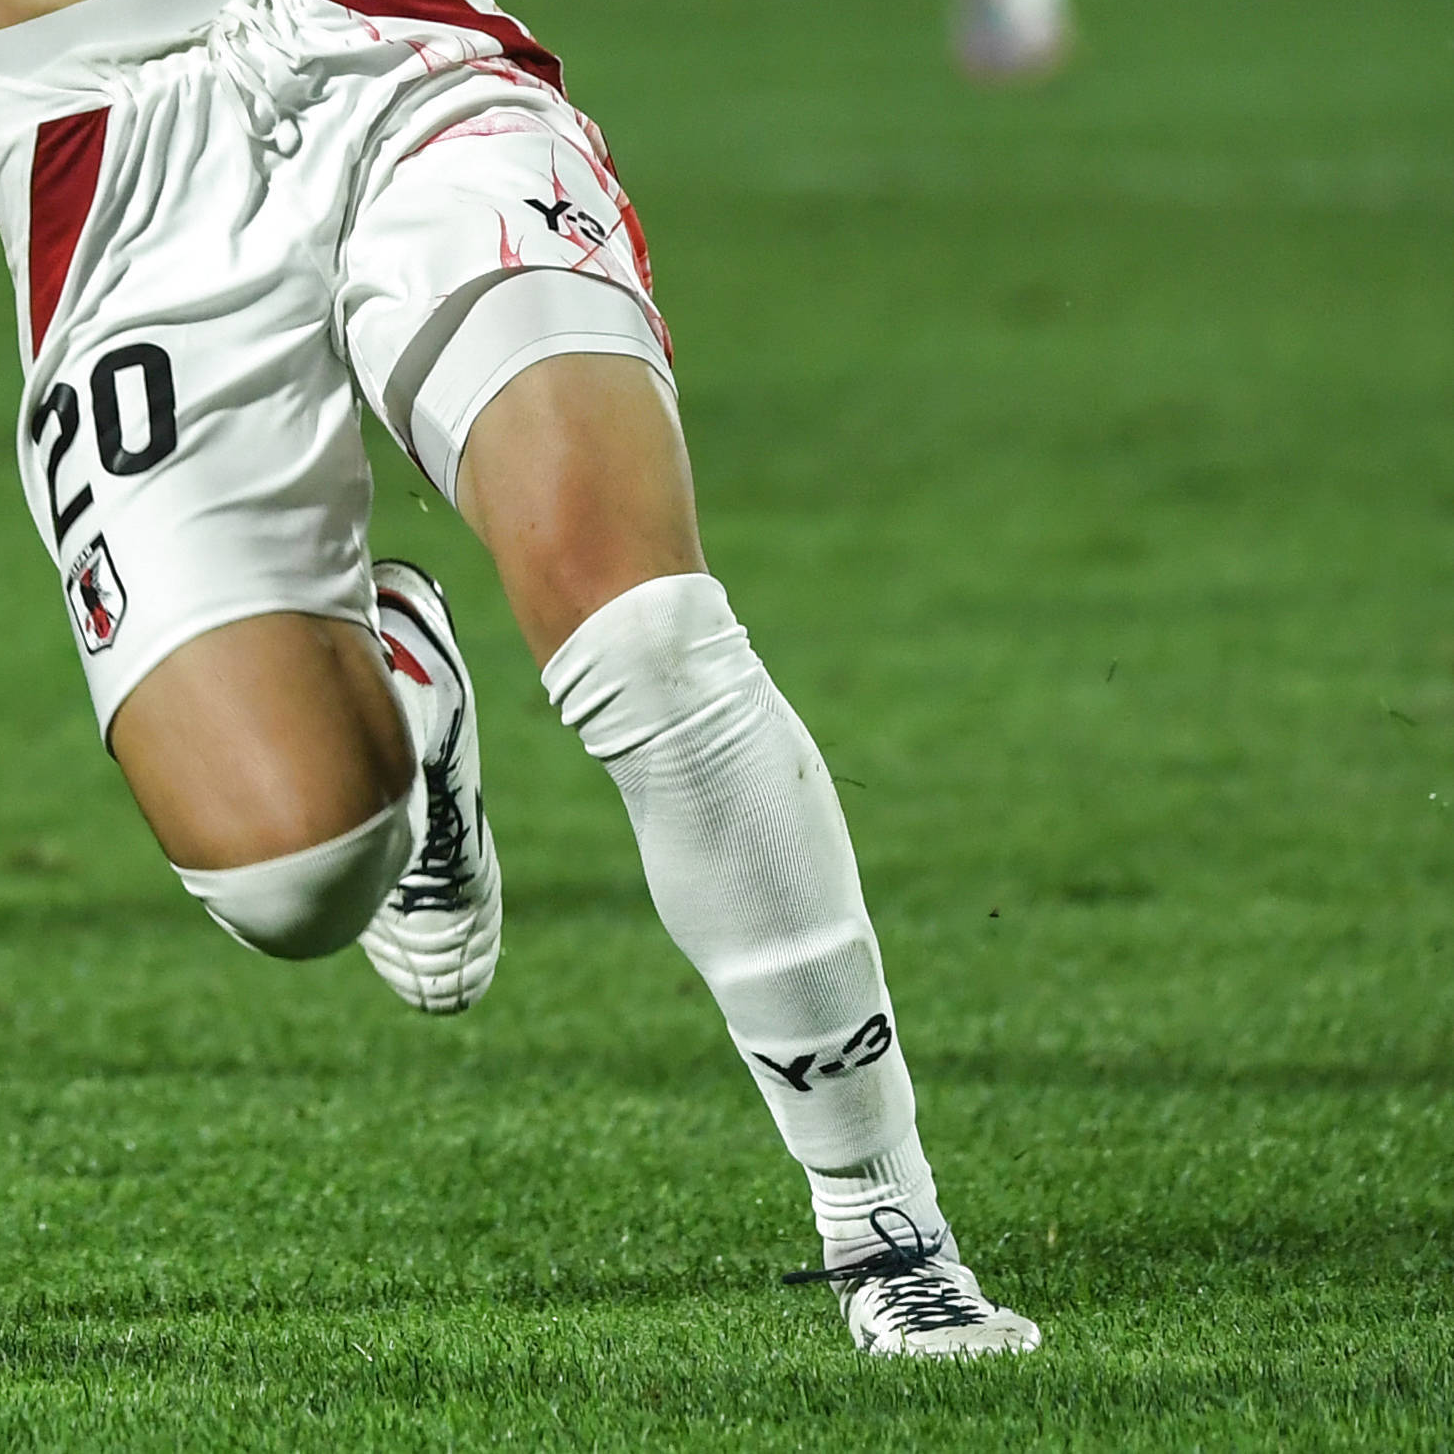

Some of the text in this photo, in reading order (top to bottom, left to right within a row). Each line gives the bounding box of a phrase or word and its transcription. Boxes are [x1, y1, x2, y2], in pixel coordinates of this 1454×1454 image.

[522, 198, 607, 247] Y-3
[31, 342, 179, 548] 20
[752, 1012, 893, 1092] Y-3
